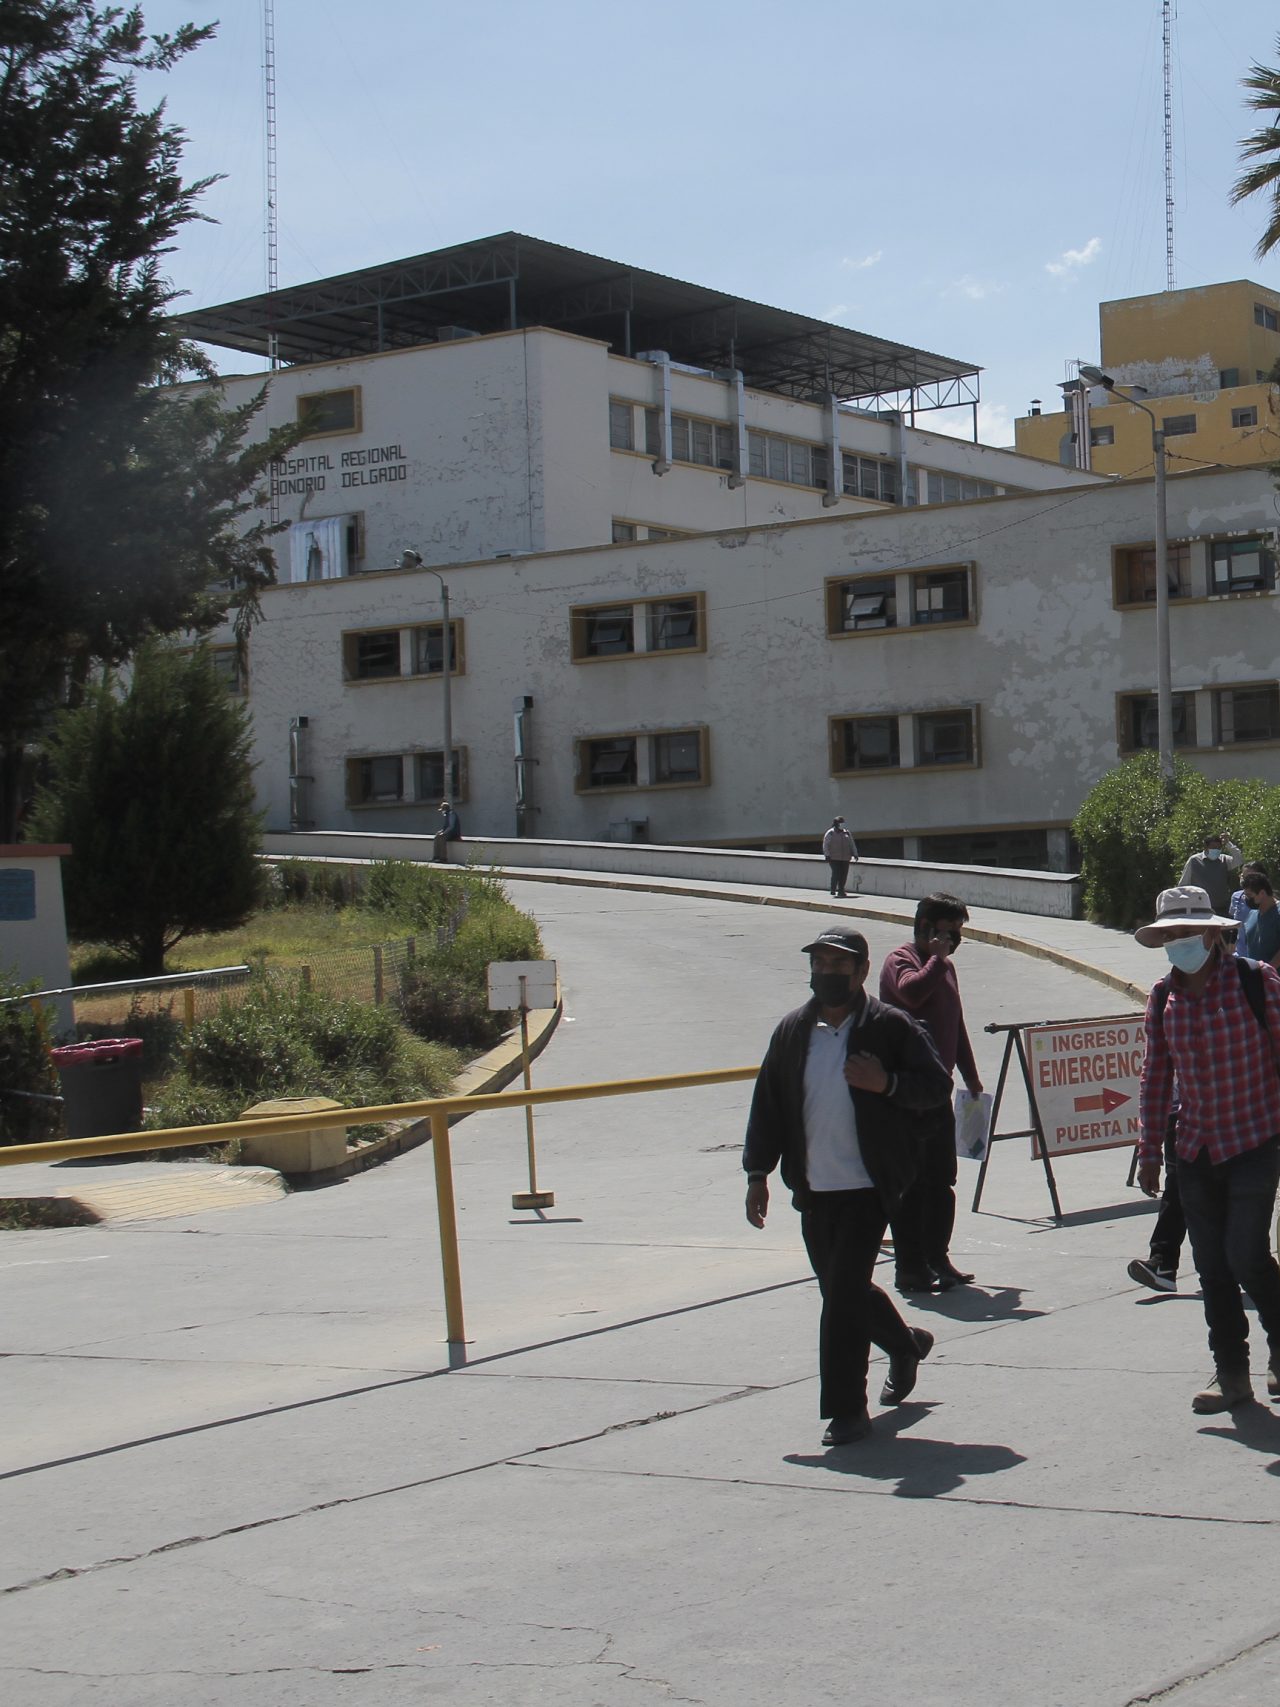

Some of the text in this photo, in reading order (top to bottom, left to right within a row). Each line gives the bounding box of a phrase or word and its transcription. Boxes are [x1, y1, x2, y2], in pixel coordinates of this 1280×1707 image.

[270, 444, 407, 477] HOSPITAL REGIONAL
[270, 465, 407, 496] HONORIO DELGADO
[1052, 1028, 1129, 1053] INGRESO
[1039, 1049, 1146, 1088] EMERGENC
[1056, 1119, 1123, 1144] PUERTA
